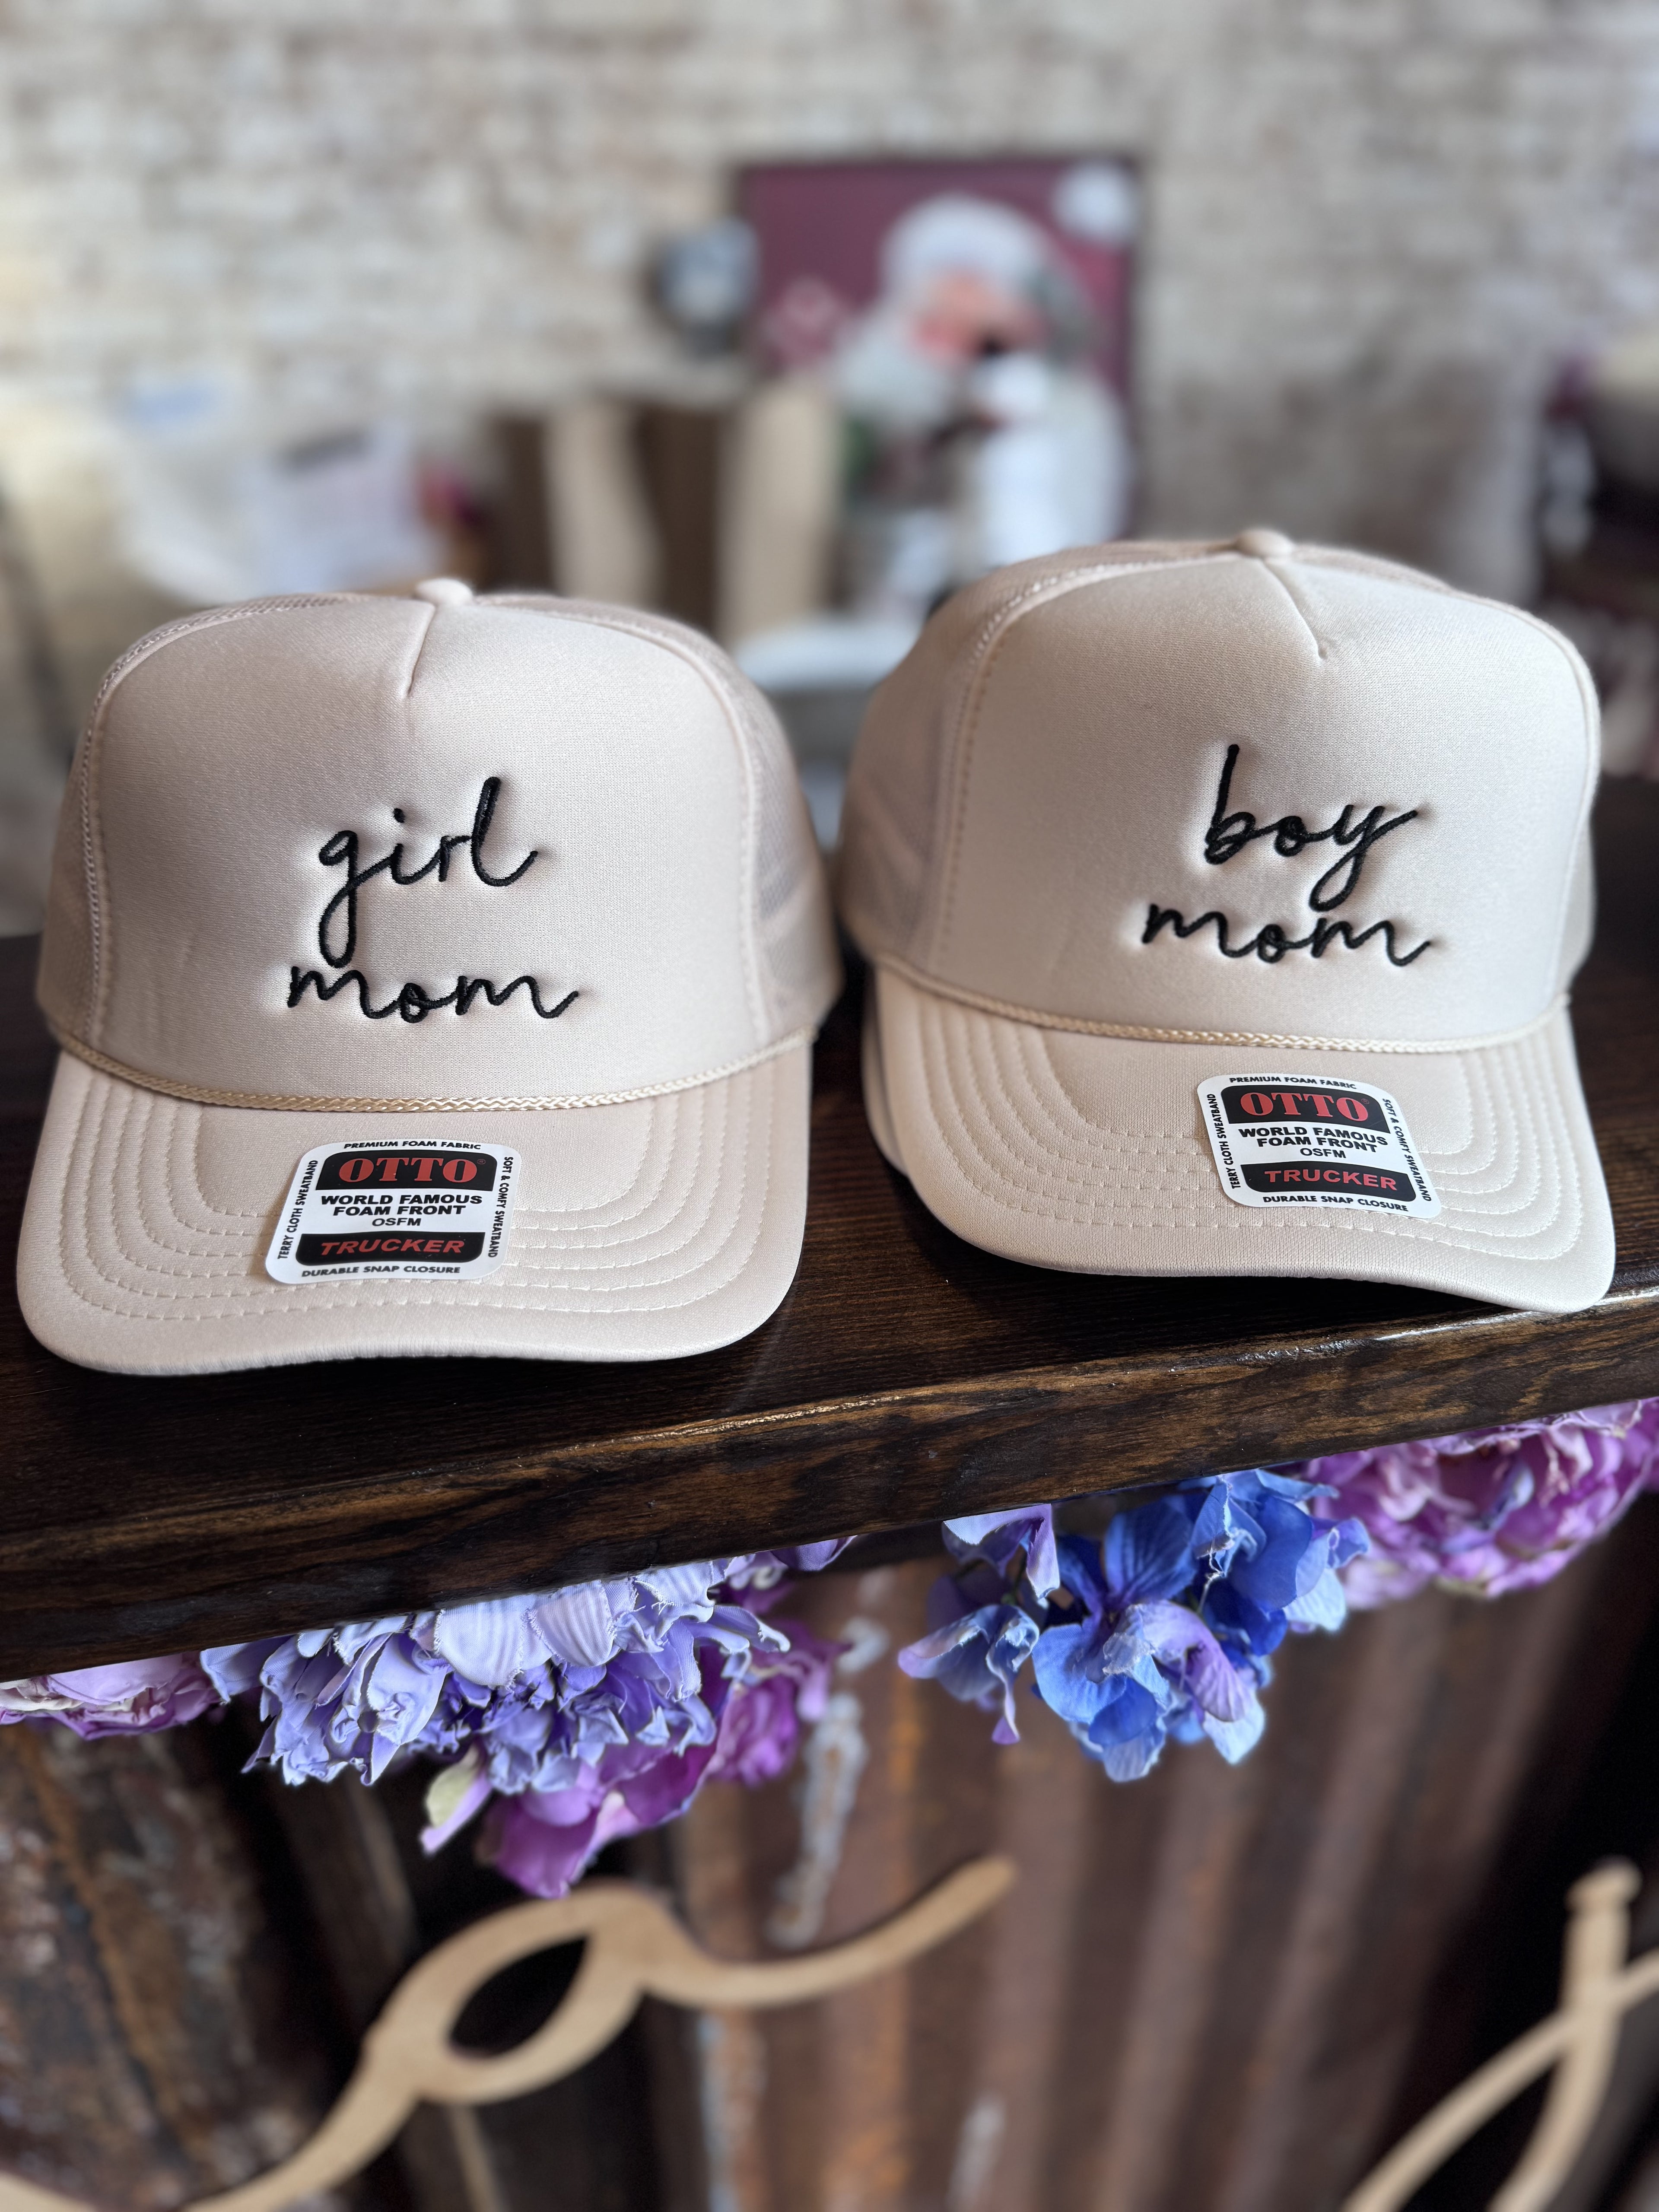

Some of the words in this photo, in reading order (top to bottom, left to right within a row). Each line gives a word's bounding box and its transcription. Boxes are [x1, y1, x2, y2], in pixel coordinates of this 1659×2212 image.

[1205, 744, 1417, 912] boy
[319, 777, 538, 968] girl
[1142, 904, 1430, 966] mom
[288, 966, 578, 1023] mom
[1320, 1079, 1357, 1089] FABRIC
[1207, 1094, 1227, 1139] SWEATBAND
[1239, 1127, 1307, 1137] WORLD
[1313, 1128, 1388, 1145] FAMOUS
[1257, 1137, 1311, 1147] FOAM
[1316, 1138, 1377, 1152] FRONT
[1219, 1141, 1233, 1165] CLOTH
[1300, 1148, 1346, 1158] OSFM
[1383, 1099, 1396, 1116] SOFT
[1394, 1126, 1411, 1153] COMFY
[1405, 1154, 1432, 1201] SWEATBAND
[502, 1157, 513, 1173] SOFT
[1226, 1167, 1241, 1189] TERRY
[1265, 1170, 1397, 1191] TRUCKER
[321, 1195, 393, 1205] WORLD
[400, 1195, 482, 1204] FAMOUS
[496, 1183, 509, 1208] COMFY
[1263, 1195, 1317, 1204] DURABLE
[1357, 1199, 1408, 1211] CLOSURE
[277, 1235, 294, 1259] TERRY
[287, 1208, 303, 1233] CLOTH
[295, 1160, 318, 1206] SWEATBAND
[333, 1206, 390, 1216] FOAM
[397, 1206, 466, 1215] FRONT
[372, 1218, 421, 1227] OSFM
[488, 1210, 505, 1258] SWEATBAND
[321, 1239, 464, 1255] TRUCKER
[302, 1266, 359, 1277] DURABLE
